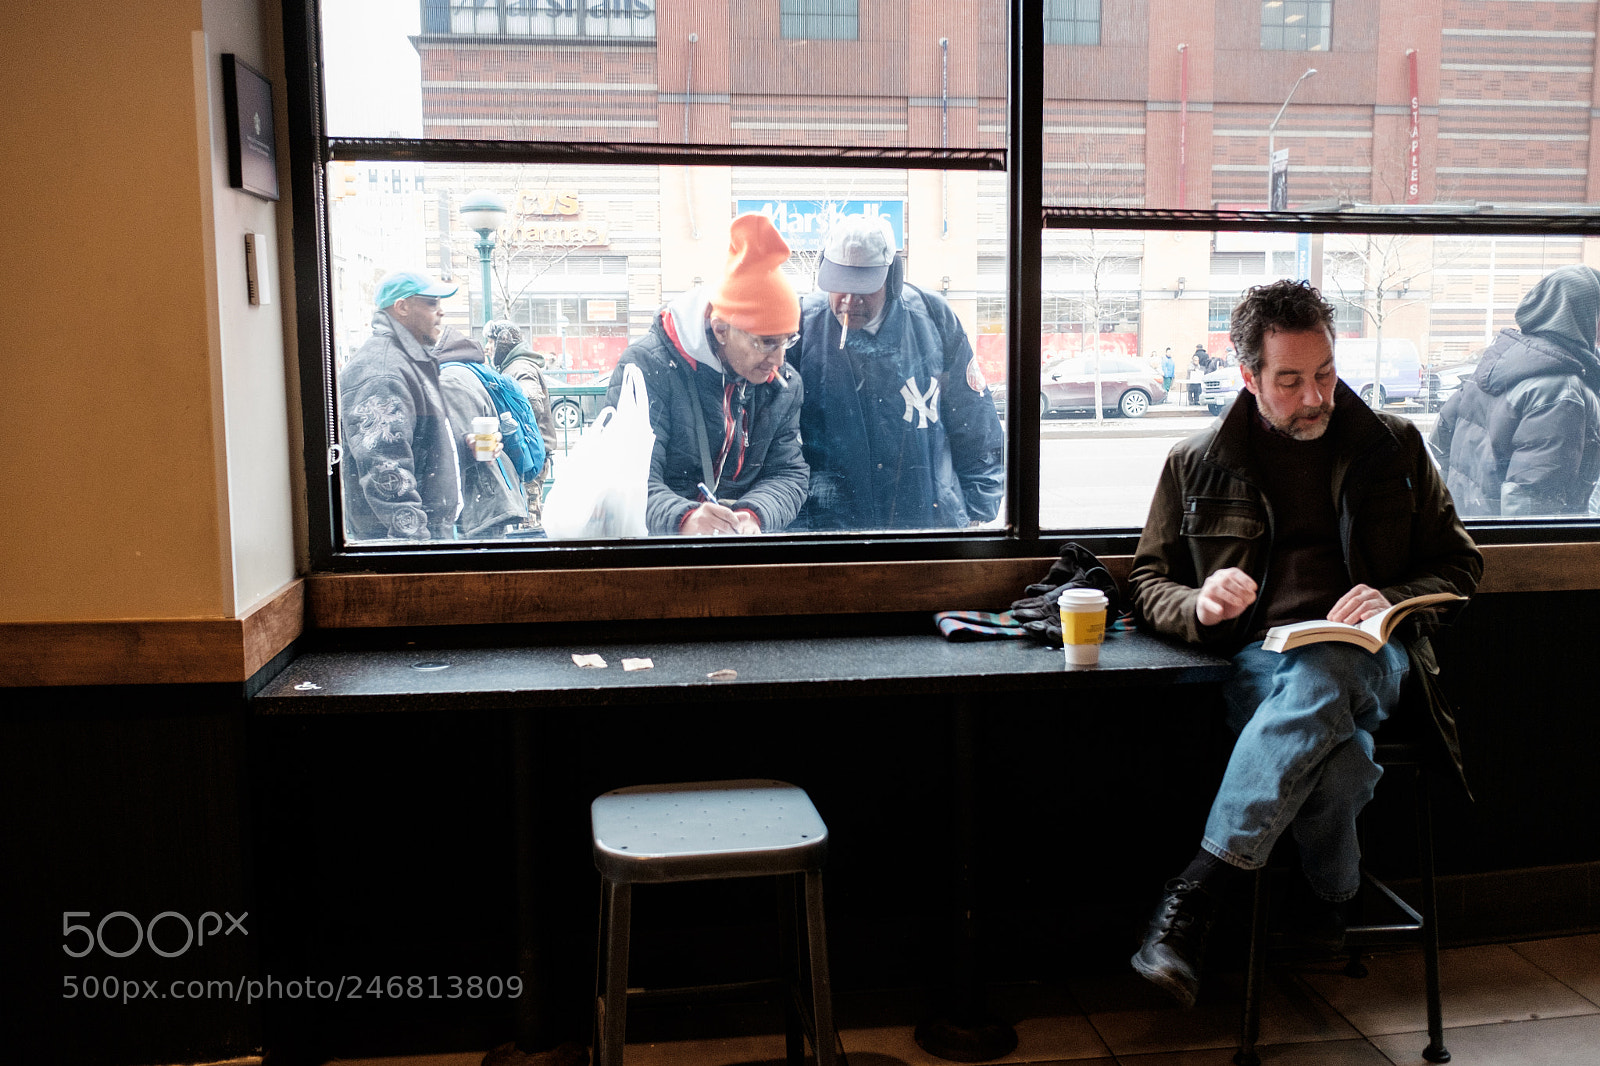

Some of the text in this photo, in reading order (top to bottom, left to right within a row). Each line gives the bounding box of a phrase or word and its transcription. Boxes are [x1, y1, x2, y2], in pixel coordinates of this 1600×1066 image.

[1410, 96, 1419, 196] STAPLES
[517, 189, 580, 215] CVS
[759, 202, 892, 233] Marsh
[899, 376, 940, 429] NY
